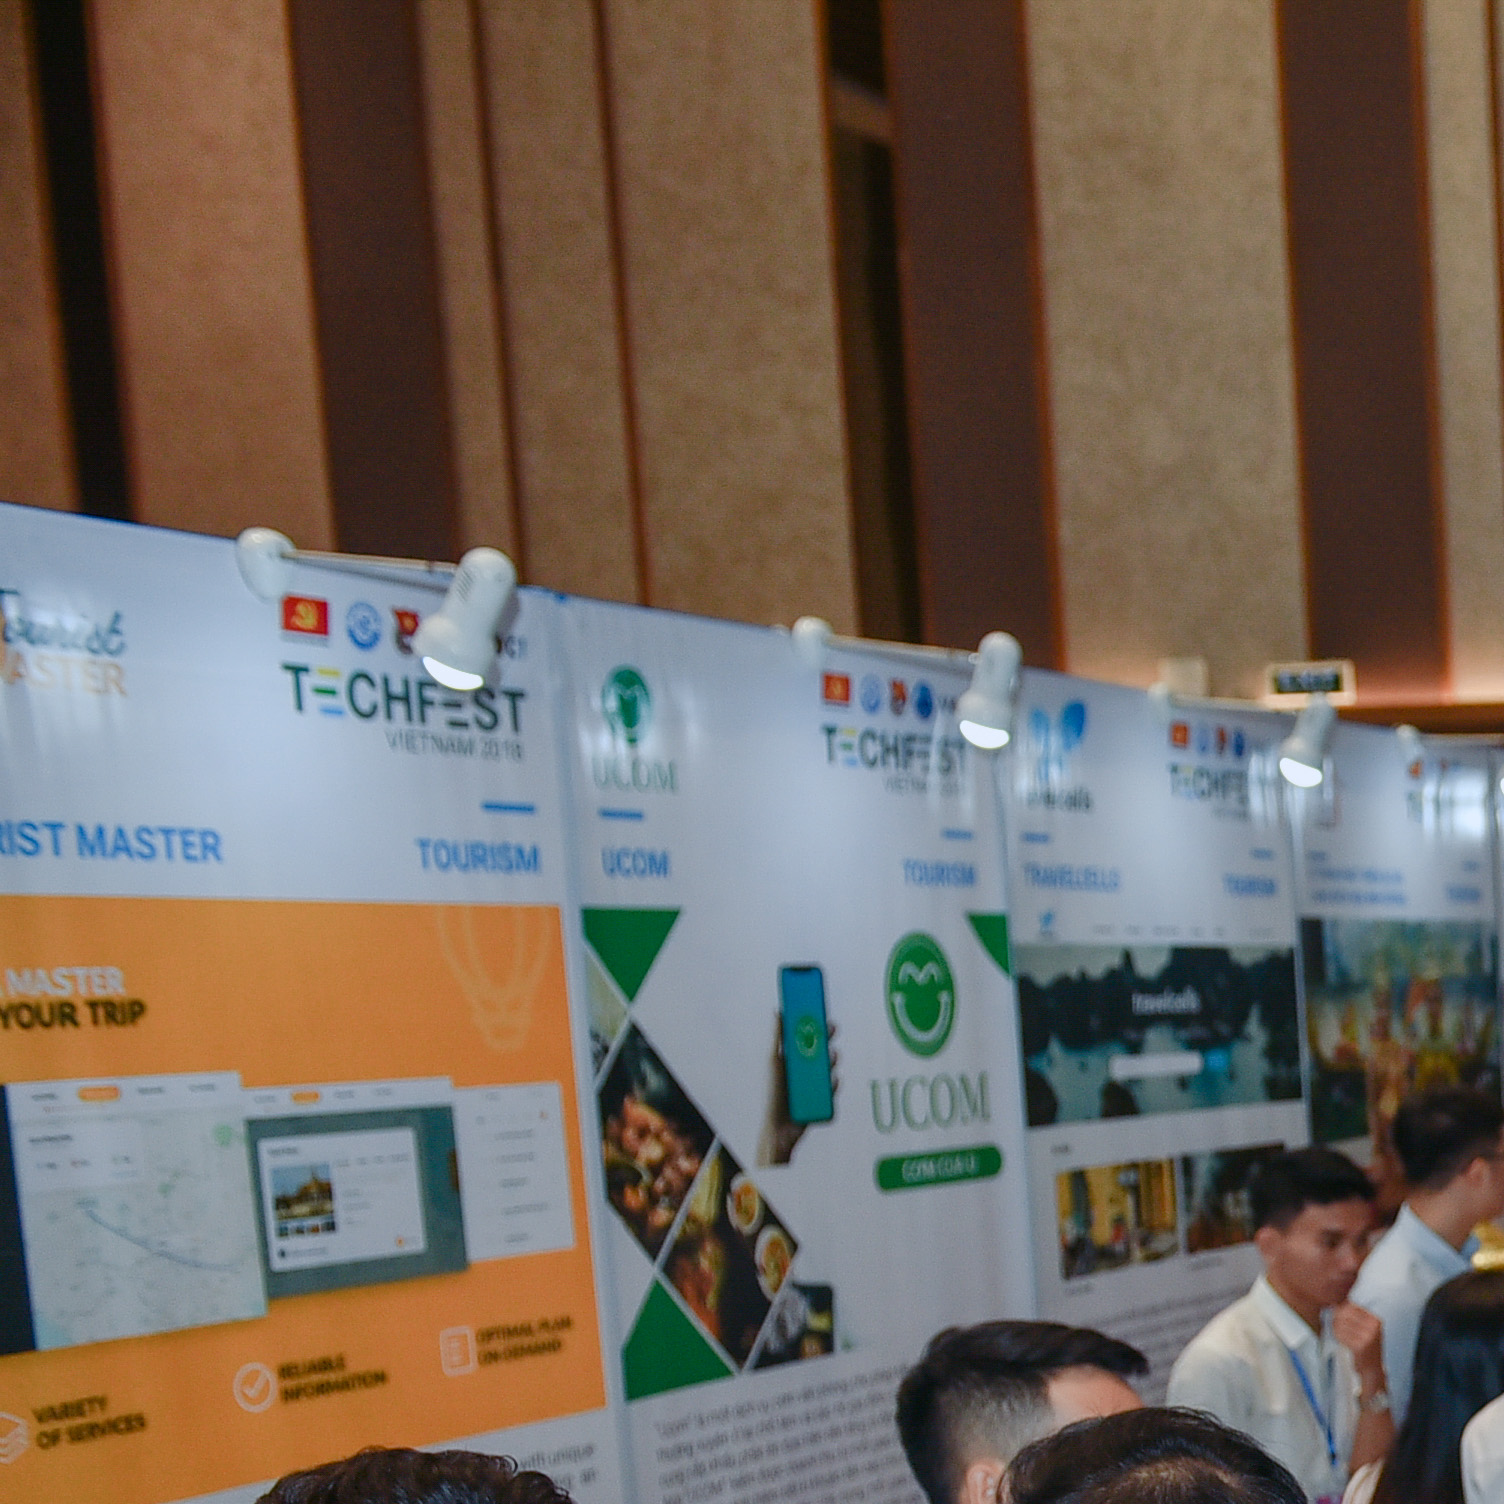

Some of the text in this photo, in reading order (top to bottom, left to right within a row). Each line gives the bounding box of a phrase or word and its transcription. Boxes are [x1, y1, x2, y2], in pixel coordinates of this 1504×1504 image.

[281, 663, 526, 733] TECHFEST
[77, 824, 223, 864] MASTER
[417, 838, 541, 874] TOURISM
[601, 849, 670, 880] UCOM
[904, 858, 977, 888] TOURISM
[5, 966, 126, 997] MASTER
[0, 998, 147, 1030] YOUR TRIP
[869, 1071, 991, 1134] UCOM
[31, 1394, 108, 1423] VARIETY
[35, 1411, 146, 1450] OF SERVICES
